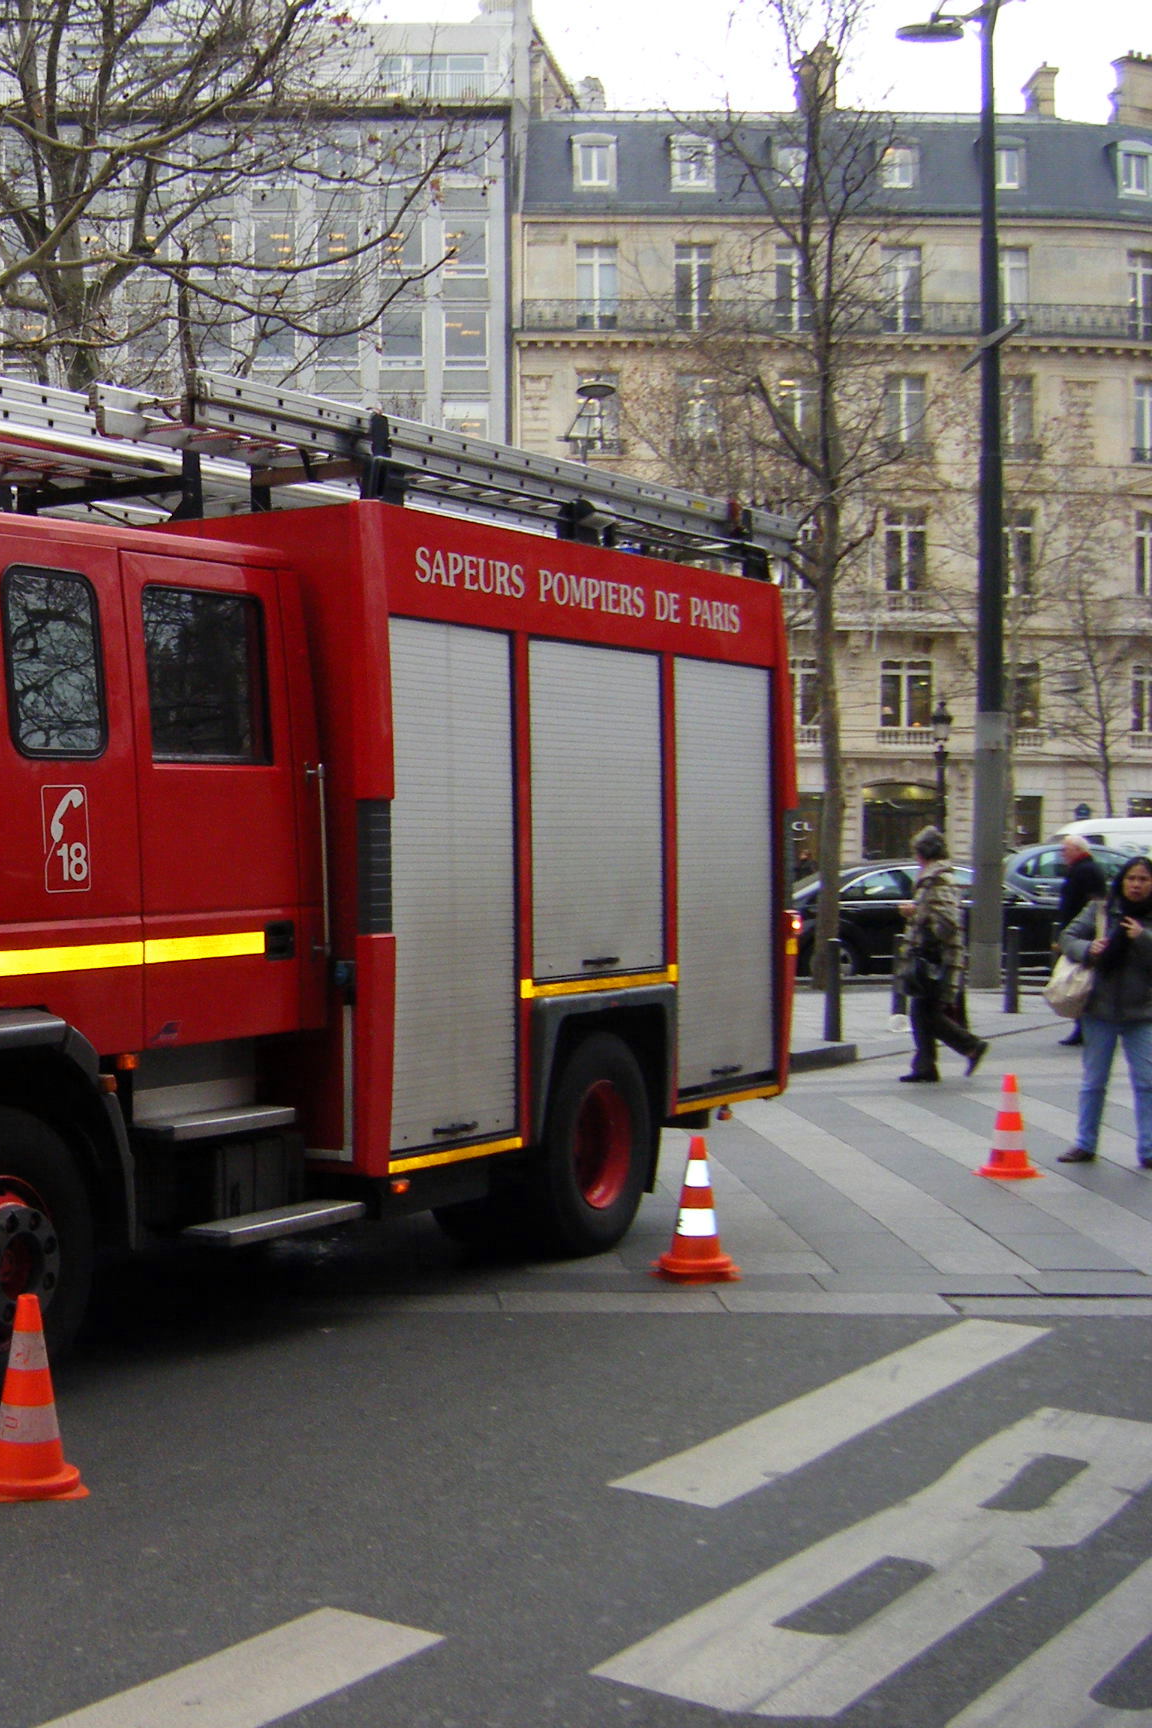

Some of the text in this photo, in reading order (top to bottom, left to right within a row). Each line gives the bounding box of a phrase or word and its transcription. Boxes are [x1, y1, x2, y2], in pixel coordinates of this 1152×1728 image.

[415, 547, 740, 633] SAPEURS POMPIERS DE PARIS
[56, 842, 88, 881] 18
